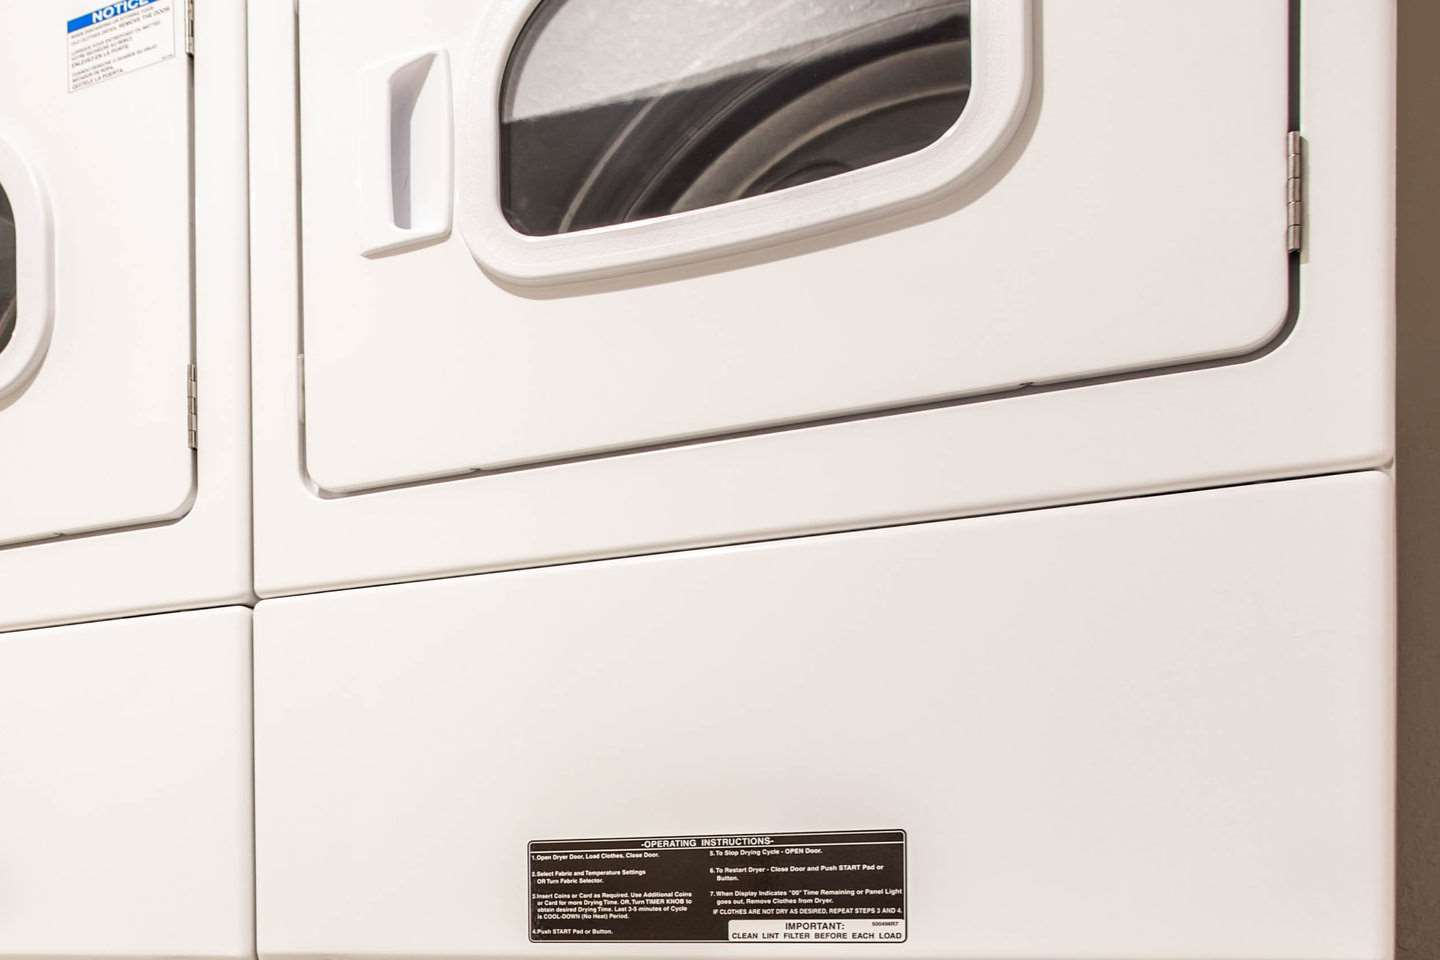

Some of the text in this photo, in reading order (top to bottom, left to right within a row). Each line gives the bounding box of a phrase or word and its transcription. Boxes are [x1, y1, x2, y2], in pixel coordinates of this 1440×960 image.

[762, 848, 779, 856] Cycle
[884, 888, 902, 896] Light
[785, 922, 845, 930] IMPORTANT:
